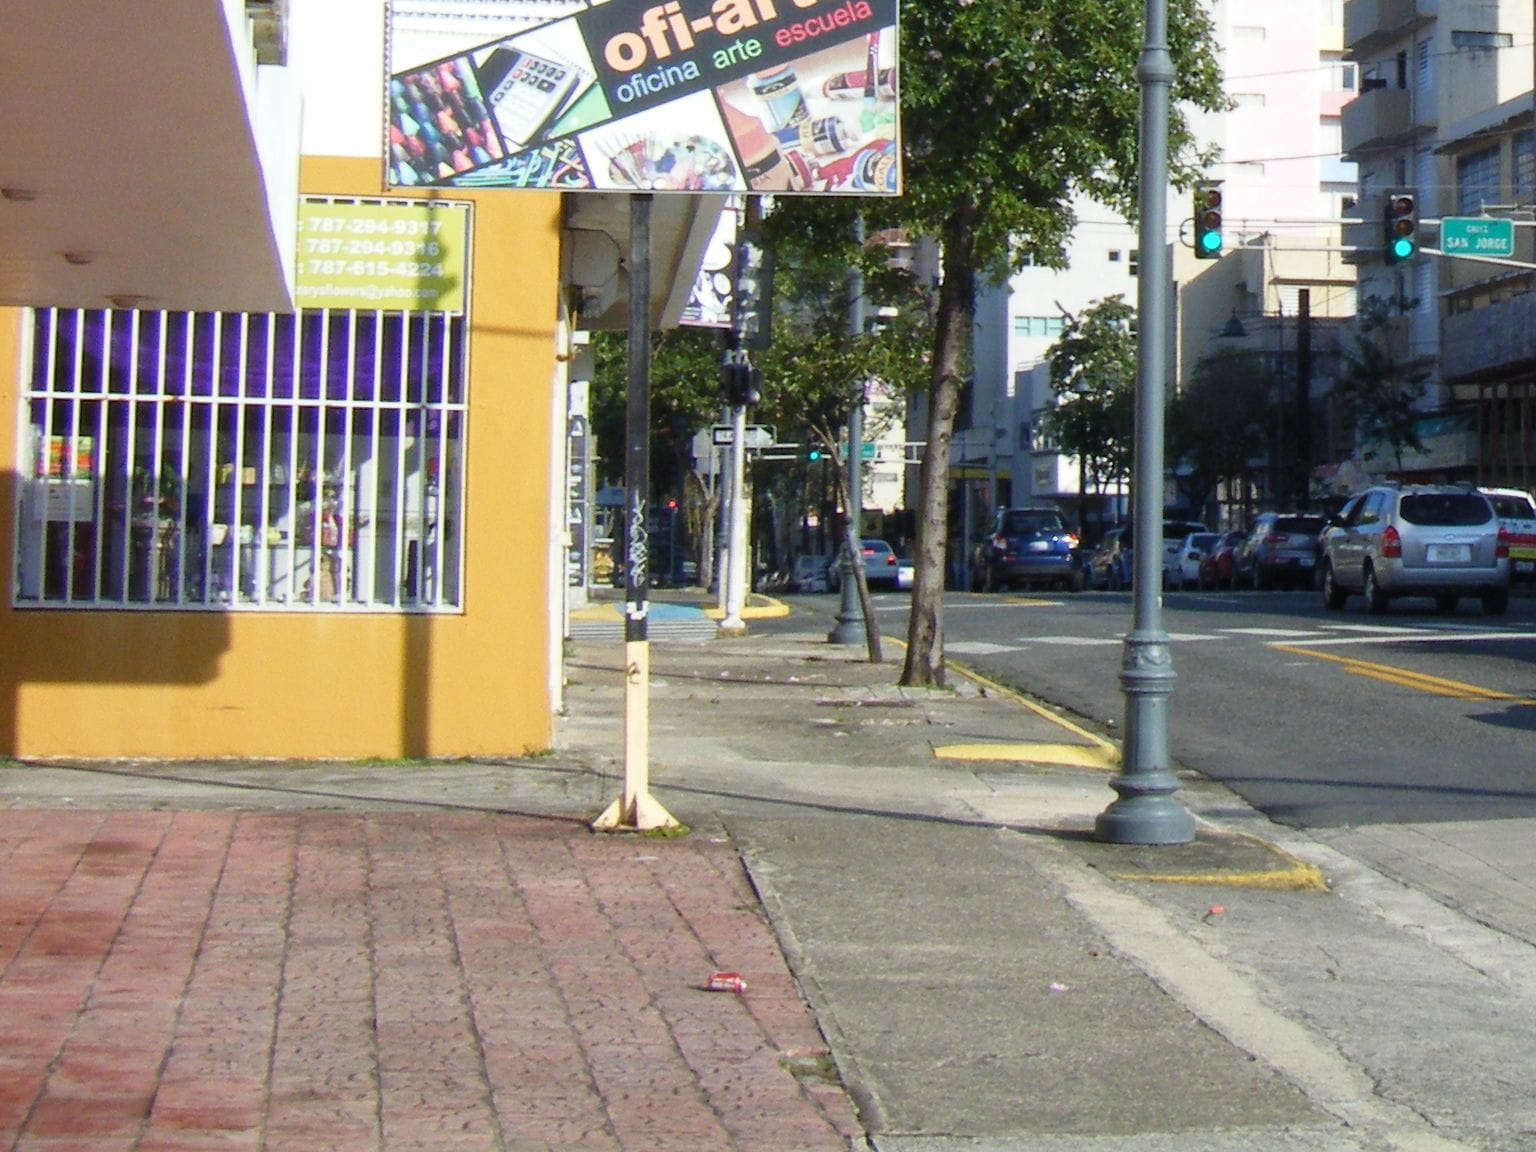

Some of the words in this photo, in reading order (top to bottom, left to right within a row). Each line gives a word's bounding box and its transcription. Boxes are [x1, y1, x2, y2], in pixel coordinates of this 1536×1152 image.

[617, 60, 700, 103] oficina
[712, 39, 762, 69] arte
[775, 0, 873, 48] escuela
[1446, 237, 1469, 249] SAN
[1476, 238, 1508, 250] JORGE
